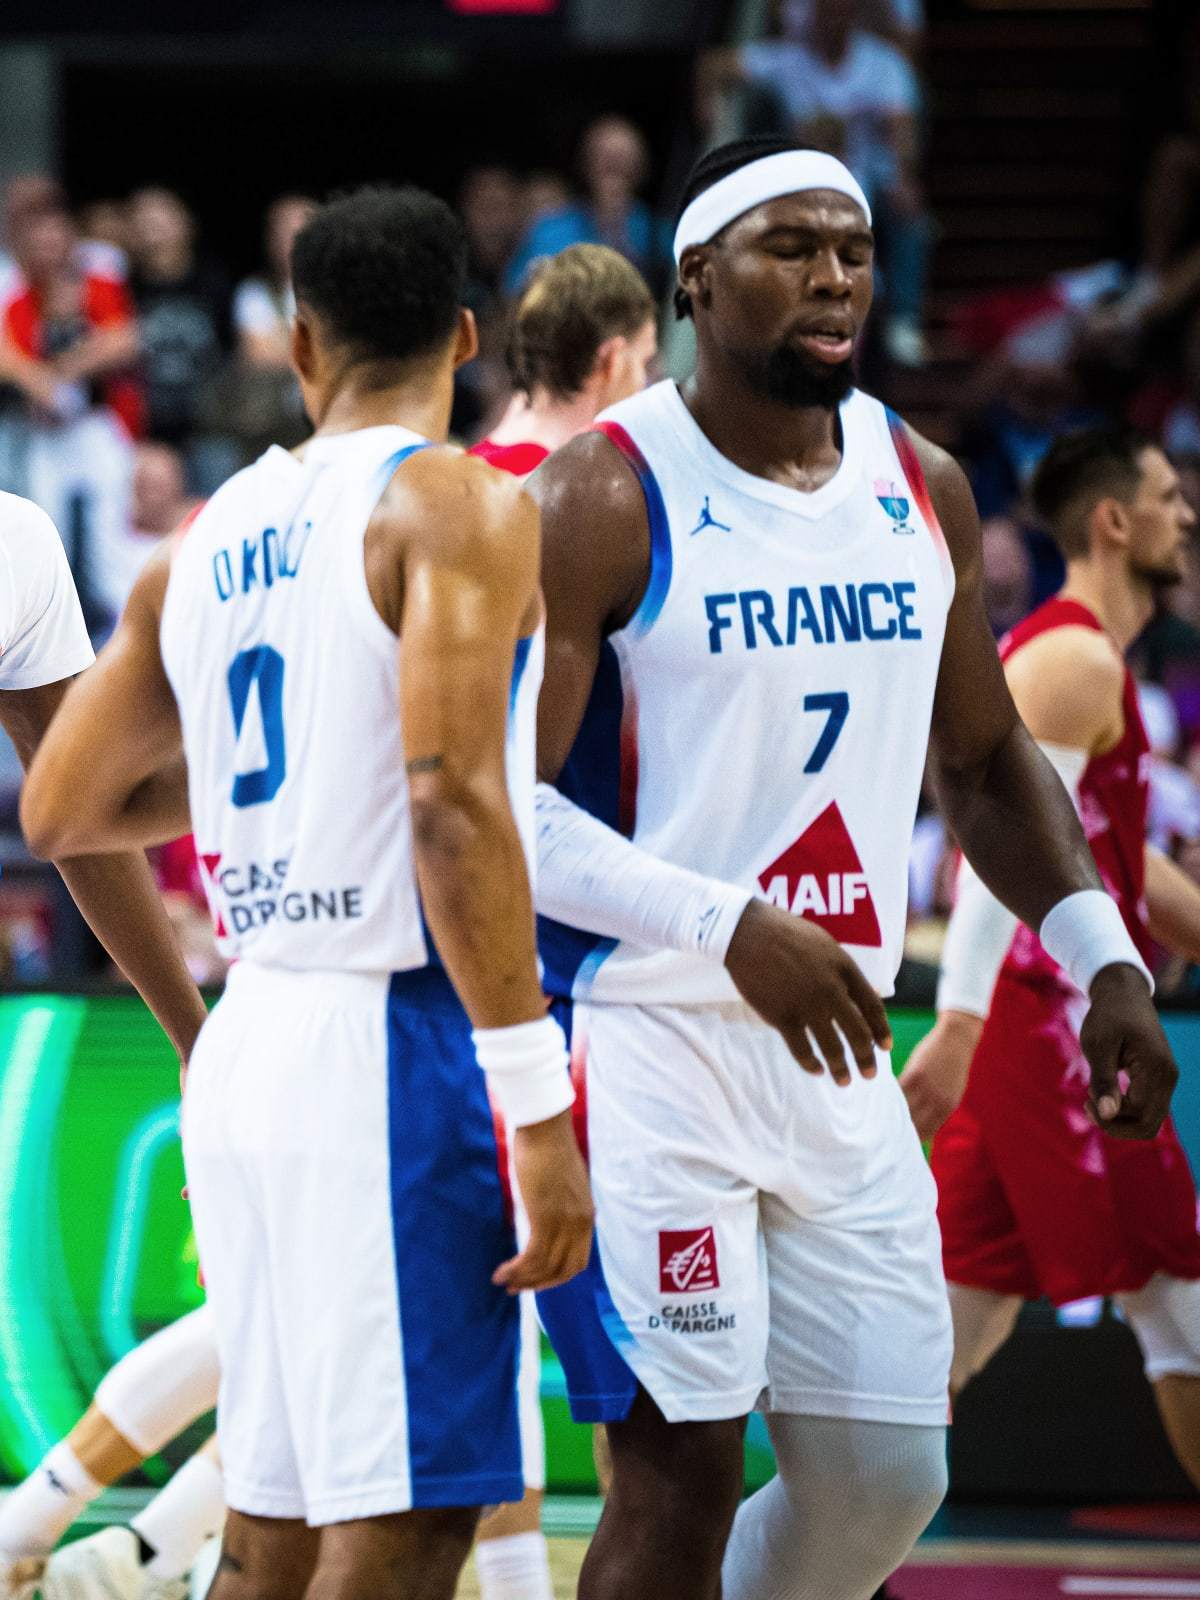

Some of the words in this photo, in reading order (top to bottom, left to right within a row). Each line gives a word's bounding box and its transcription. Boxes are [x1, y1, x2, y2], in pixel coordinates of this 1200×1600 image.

[704, 581, 923, 654] FRANCE
[803, 691, 850, 774] 7
[751, 872, 869, 917] MAIF
[661, 1301, 719, 1320] CAISSE
